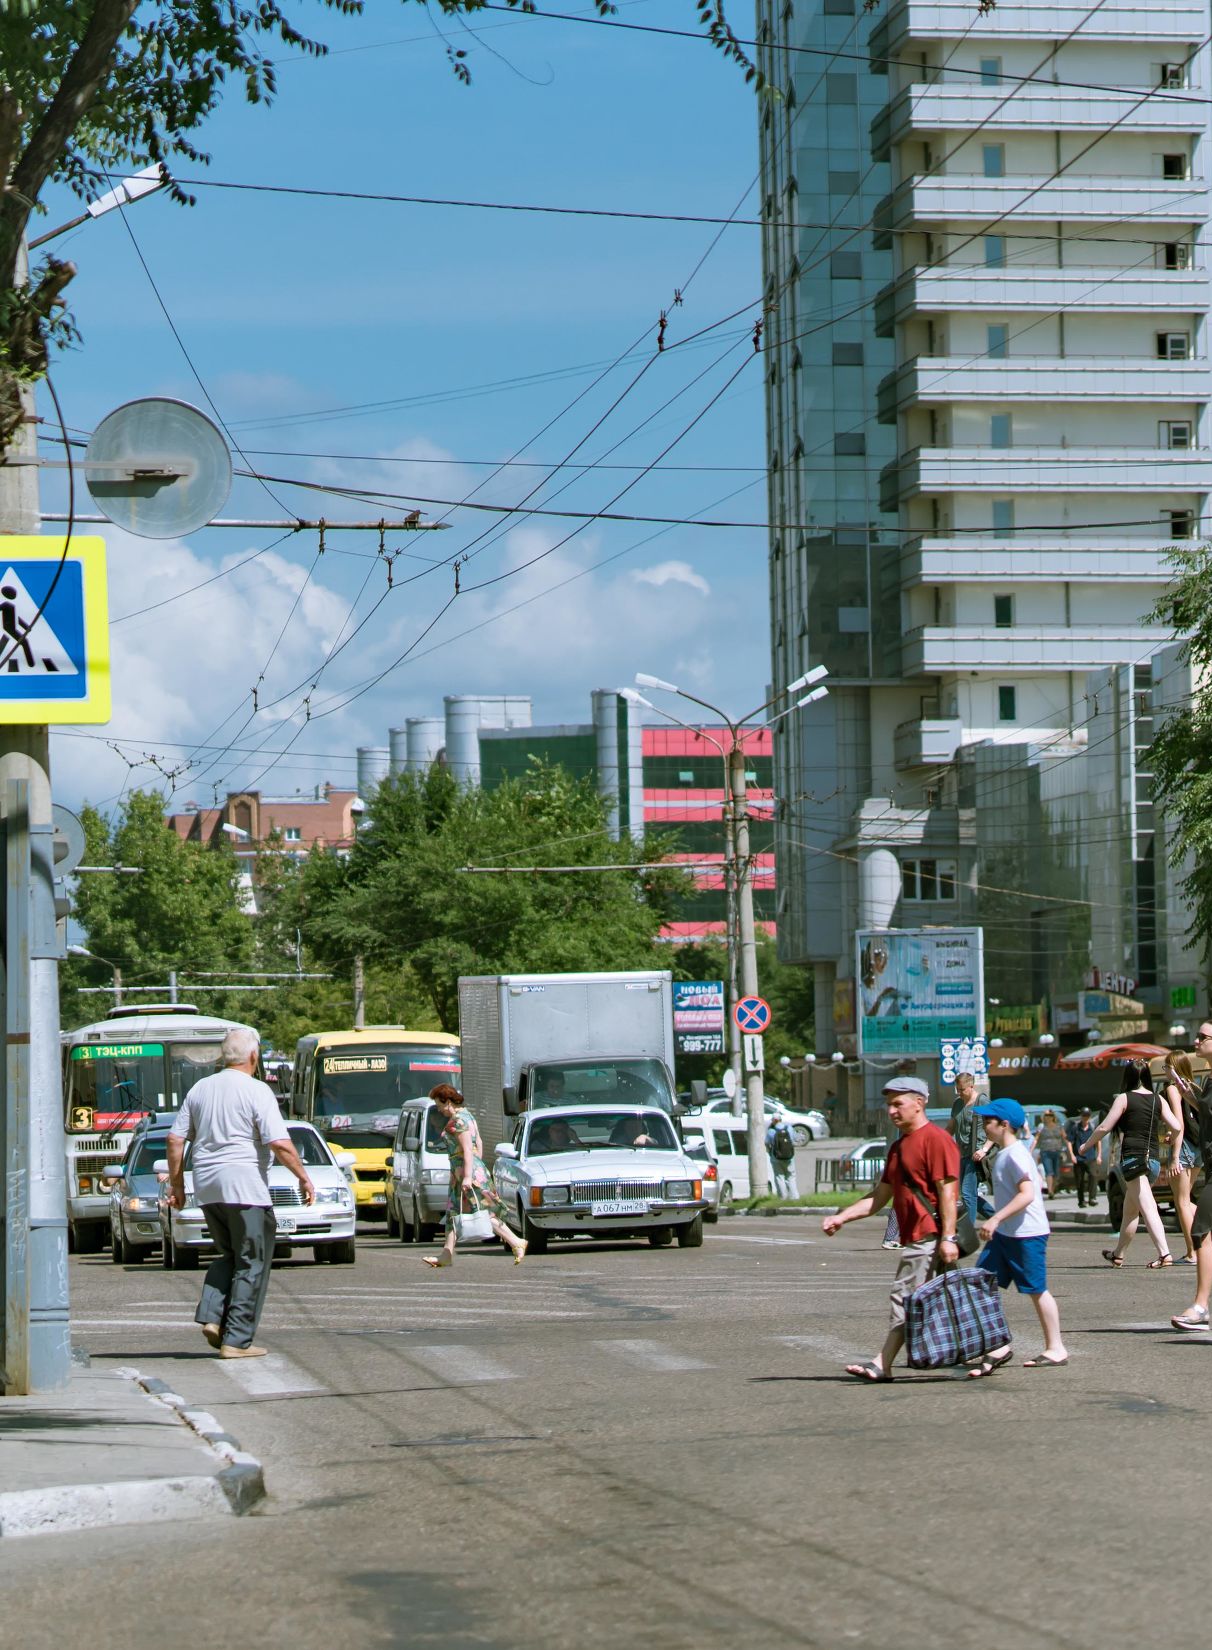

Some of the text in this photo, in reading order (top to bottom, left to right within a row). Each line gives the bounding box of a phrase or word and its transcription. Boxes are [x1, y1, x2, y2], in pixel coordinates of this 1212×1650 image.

[81, 1045, 143, 1058] 3 ТЭЦ-КПП
[998, 1054, 1050, 1068] мойка
[75, 1108, 89, 1128] 3
